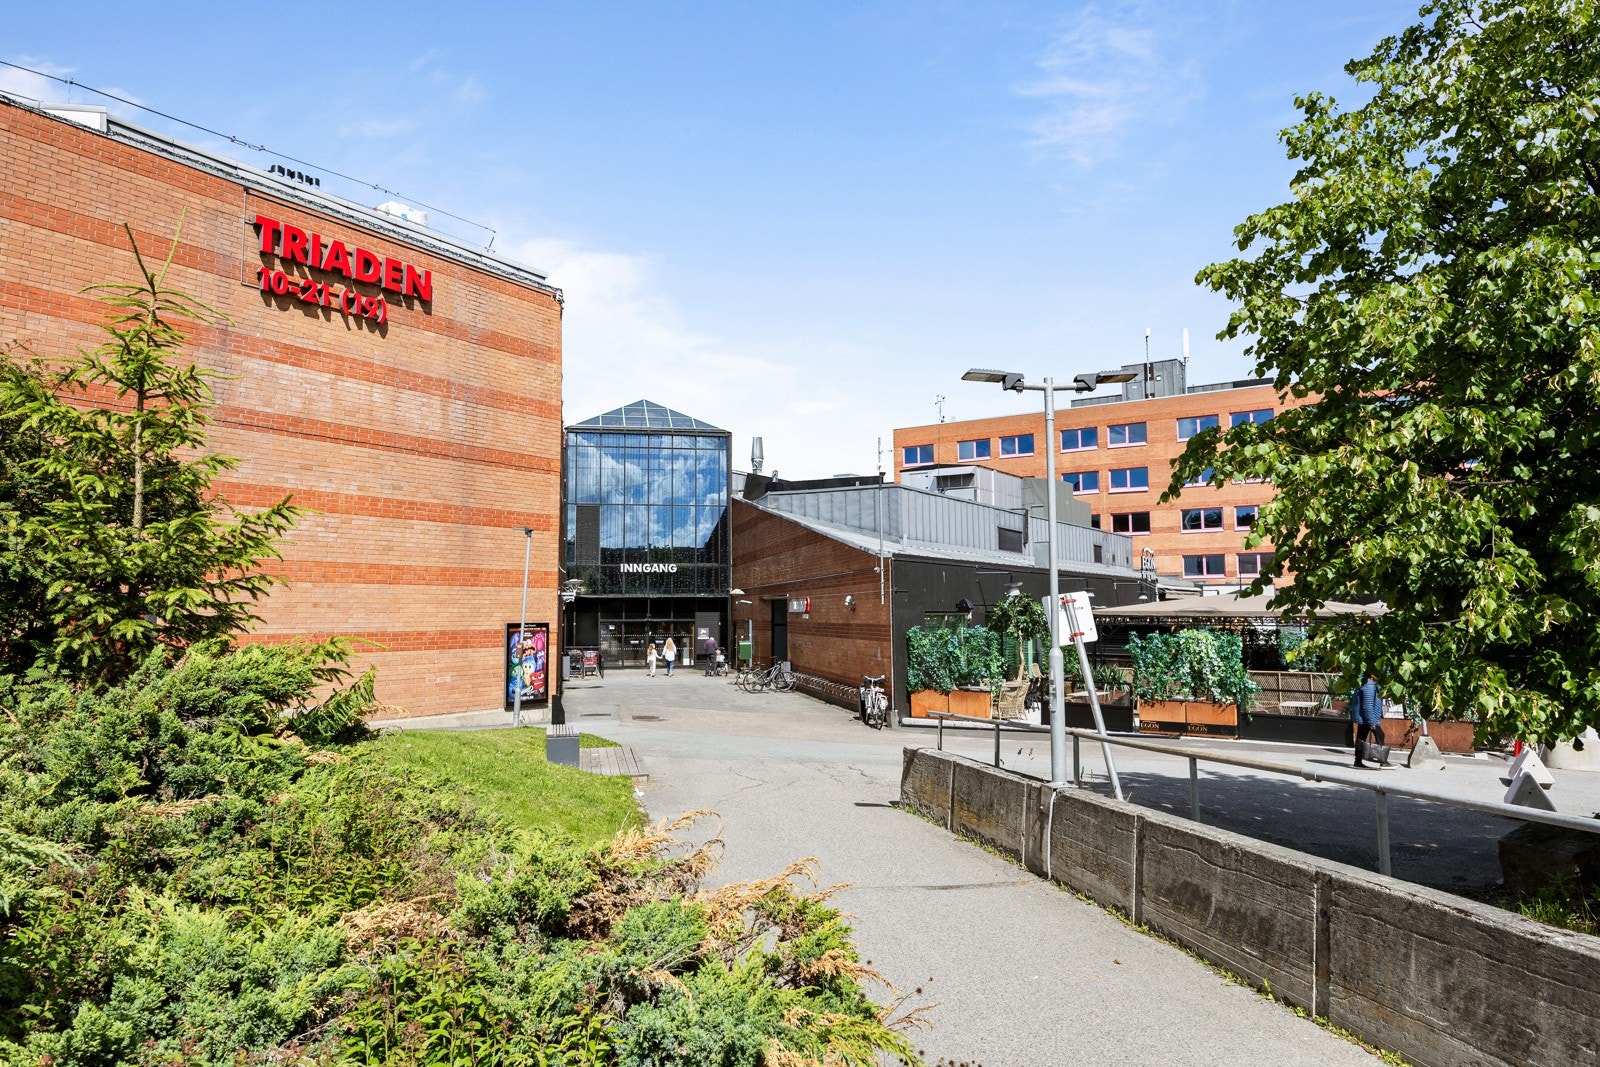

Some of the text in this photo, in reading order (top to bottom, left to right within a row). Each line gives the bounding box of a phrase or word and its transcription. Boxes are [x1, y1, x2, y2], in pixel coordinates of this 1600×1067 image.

[254, 214, 432, 301] TRIADEN
[257, 267, 388, 325] 10-21 (19)
[620, 563, 678, 573] INNGANG
[1140, 722, 1160, 730] EGON
